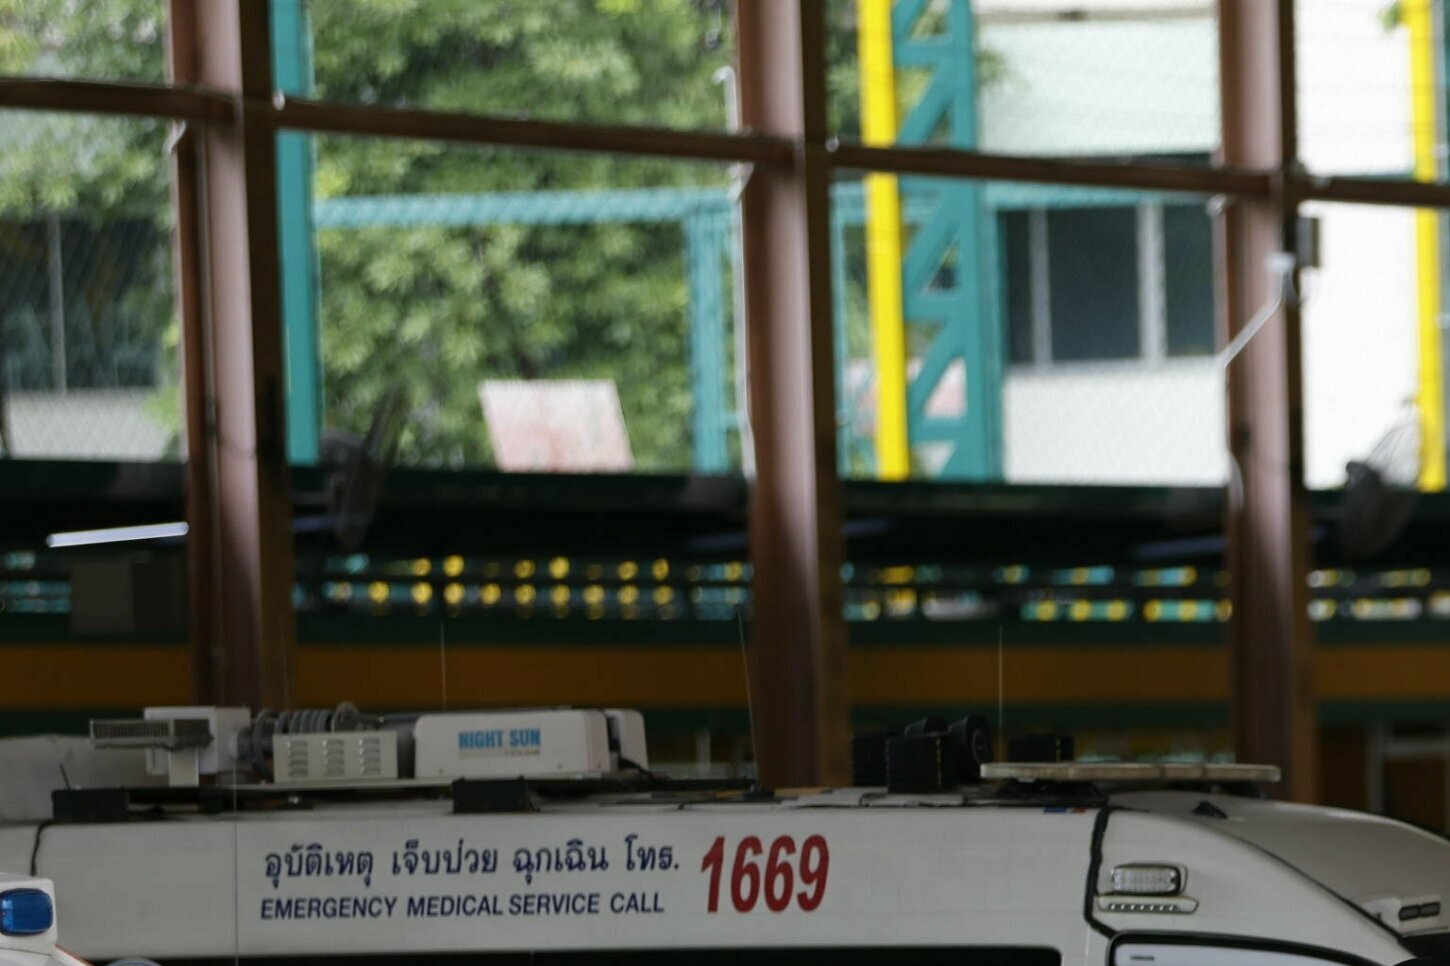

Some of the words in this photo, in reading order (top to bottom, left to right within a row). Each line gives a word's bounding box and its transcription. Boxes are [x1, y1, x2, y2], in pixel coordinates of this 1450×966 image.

[458, 730, 504, 749] NIGHT
[509, 727, 542, 747] SUN
[264, 843, 374, 889] อุบัติเหตุ
[391, 838, 499, 875] เจ็บป่วย
[512, 837, 609, 885] ฉุกเฉิน
[624, 834, 680, 872] โทร.
[700, 834, 831, 914] 1669
[260, 897, 398, 920] EMERGENCY
[406, 895, 504, 918] MEDICAL
[508, 893, 601, 916] SERVICE
[609, 892, 665, 914] CALL
